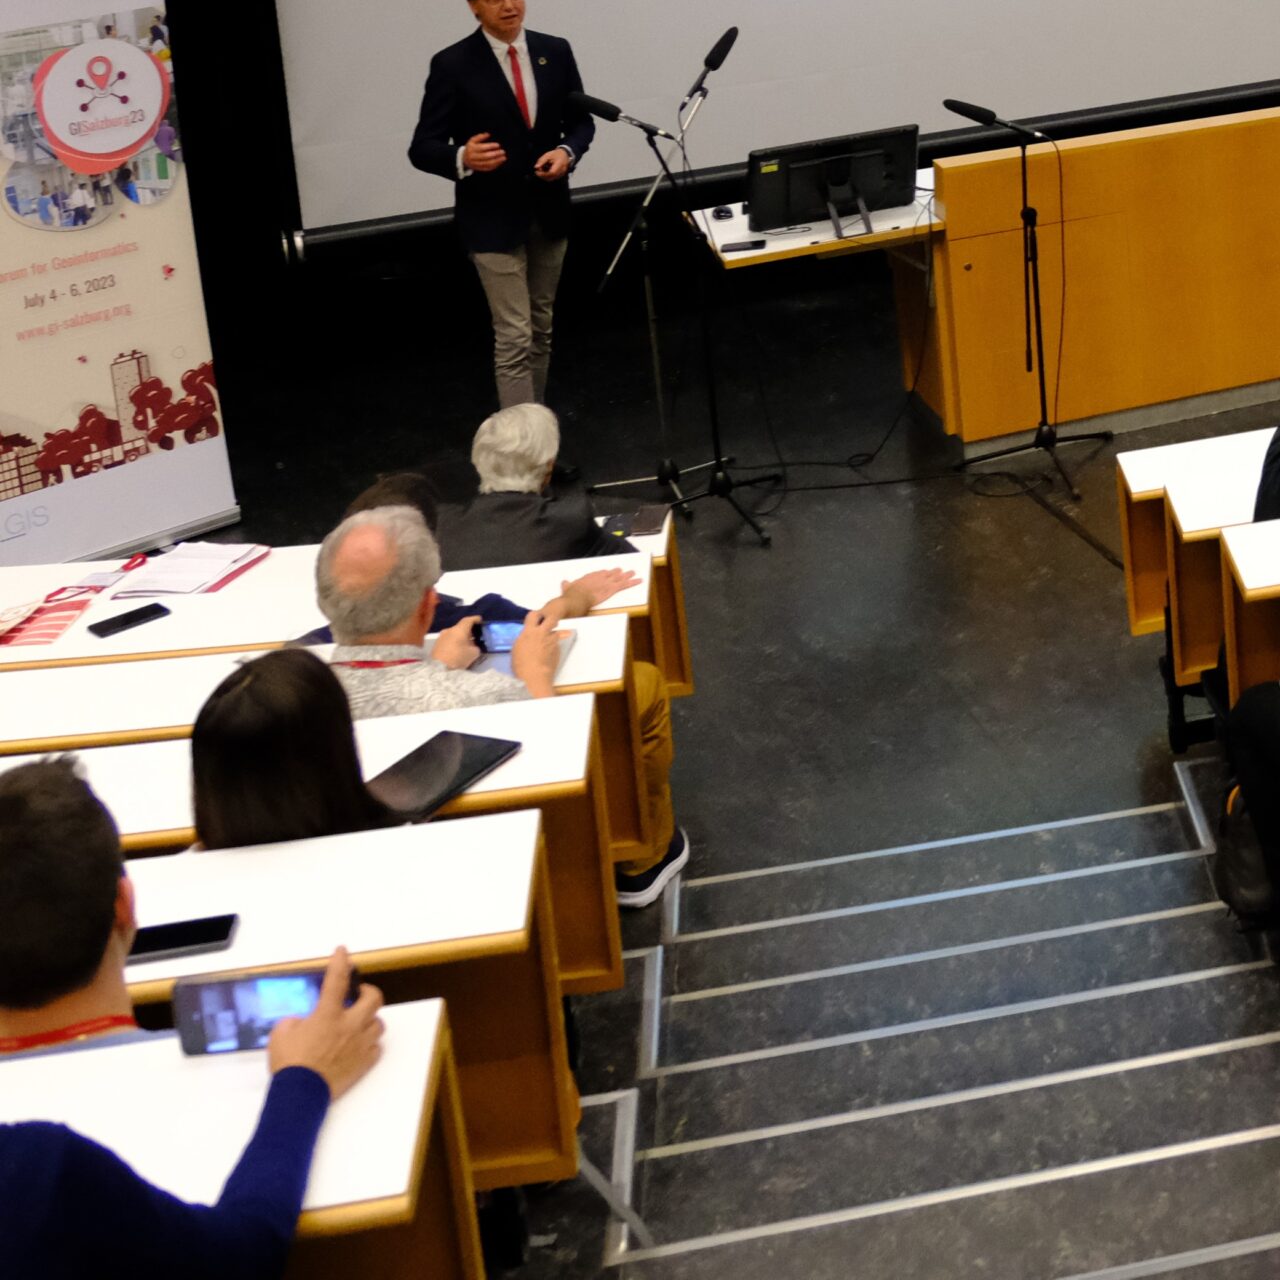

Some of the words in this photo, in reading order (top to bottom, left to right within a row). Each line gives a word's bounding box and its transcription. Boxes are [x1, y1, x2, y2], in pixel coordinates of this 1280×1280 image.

[23, 293, 46, 310] July
[49, 288, 58, 301] 4
[84, 273, 117, 294] 2023
